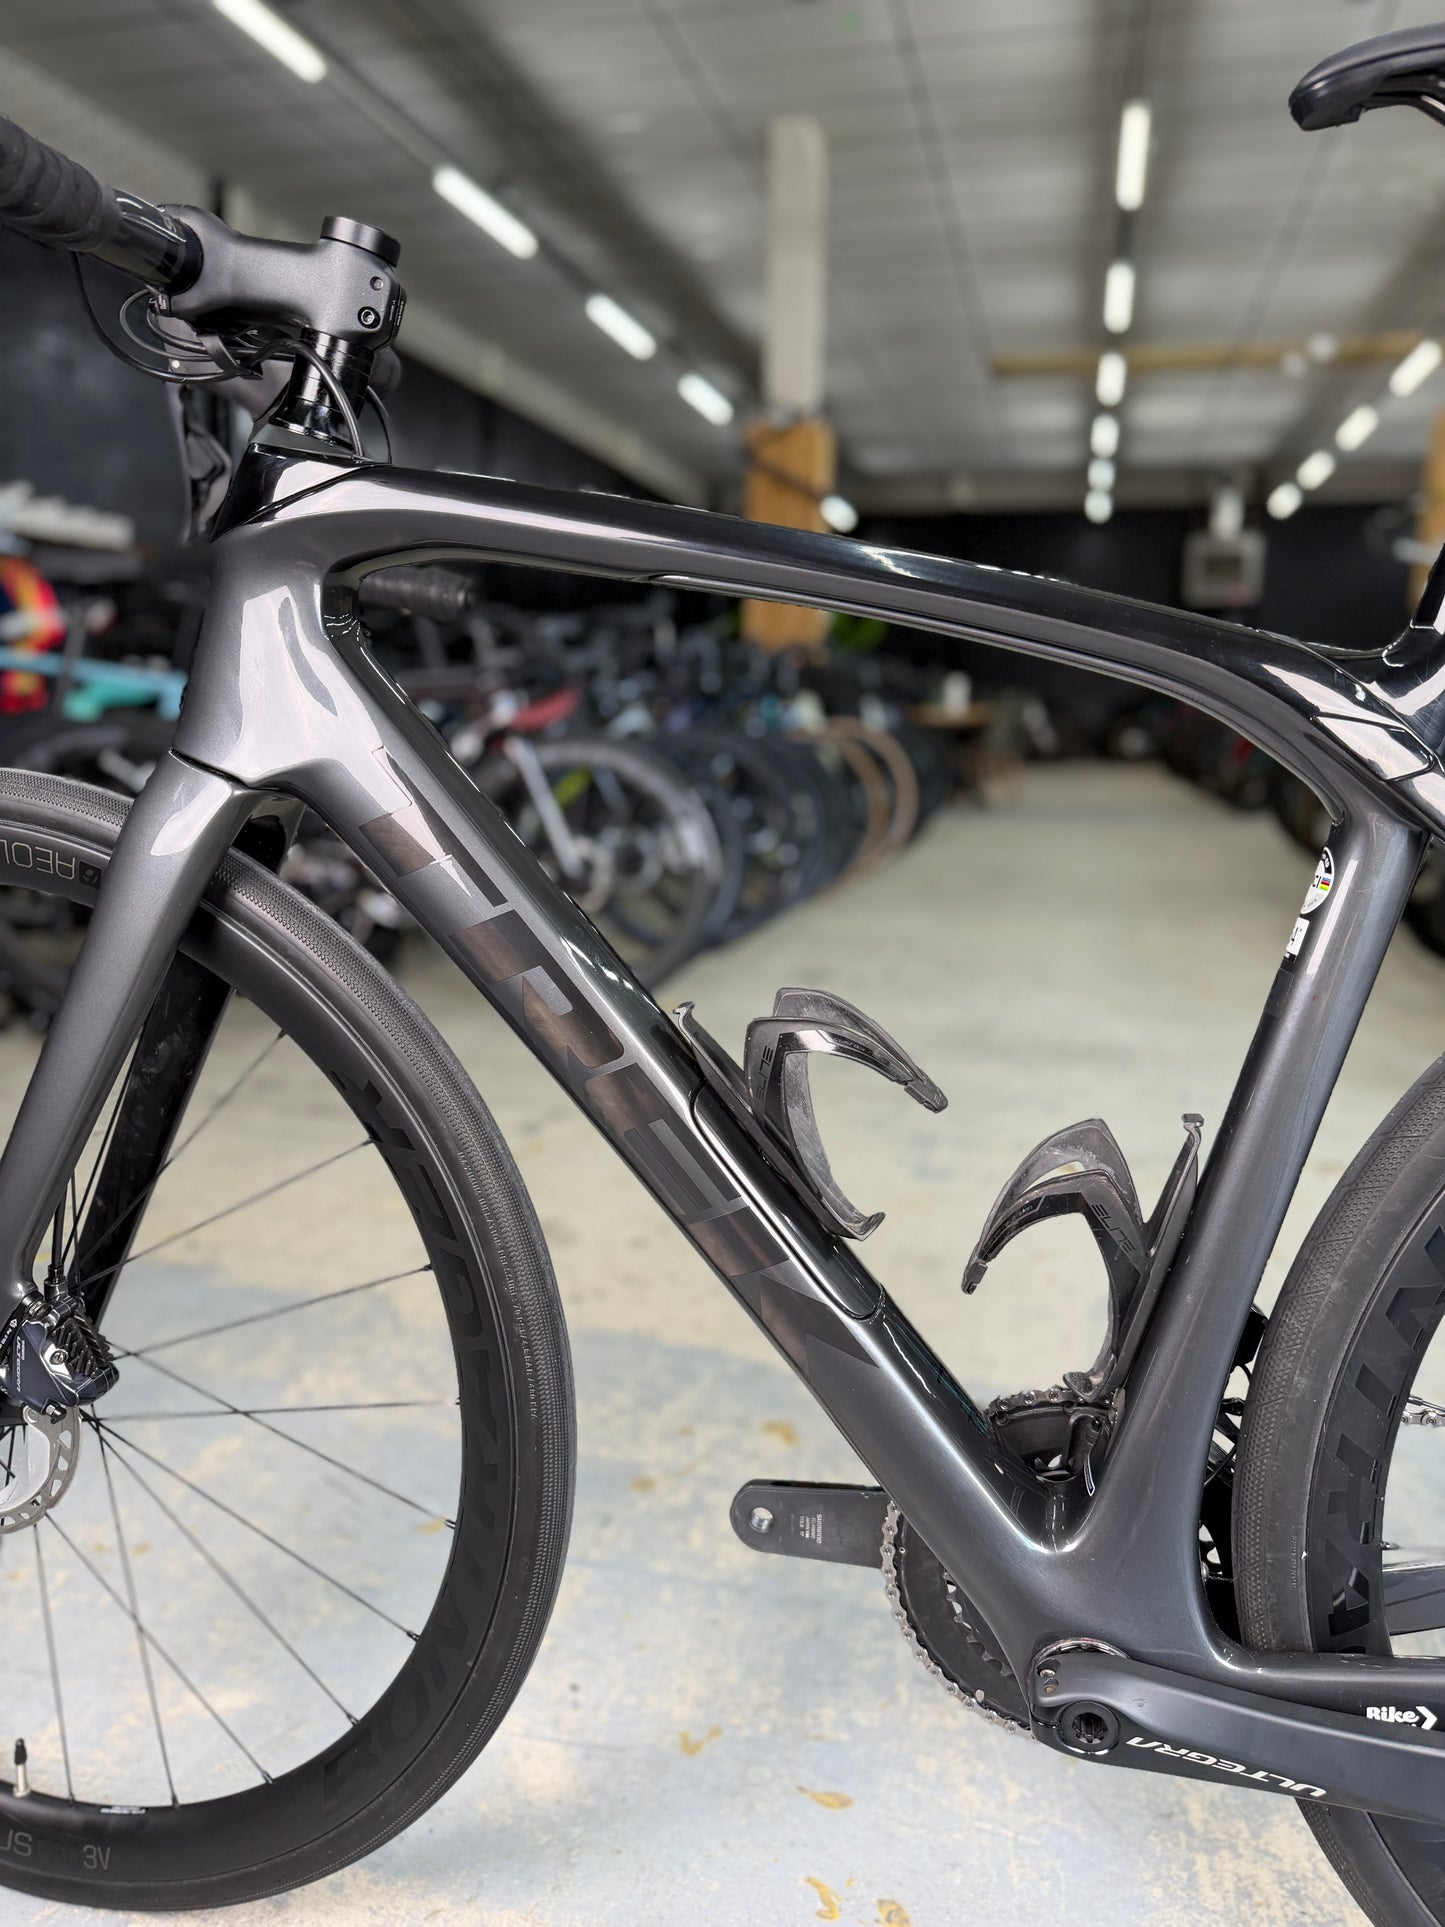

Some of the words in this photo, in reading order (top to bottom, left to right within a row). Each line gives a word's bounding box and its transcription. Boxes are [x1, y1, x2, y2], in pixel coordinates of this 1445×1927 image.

[359, 745, 879, 1373] TREK
[757, 1045, 774, 1100] ELITE
[1091, 1204, 1136, 1253] ELITE
[1126, 1736, 1327, 1798] ULTEGRA
[83, 1844, 111, 1871] 3V
